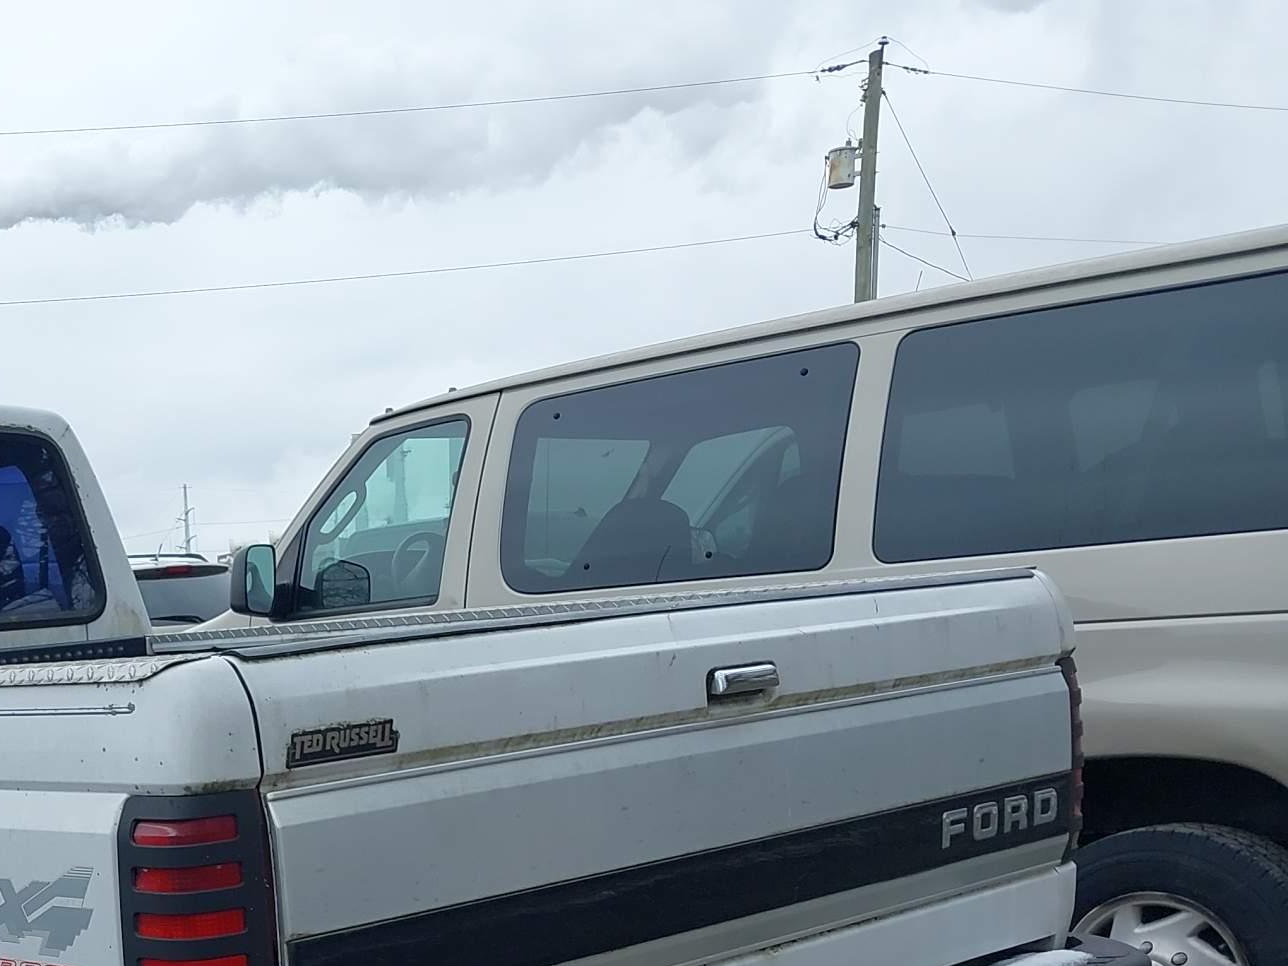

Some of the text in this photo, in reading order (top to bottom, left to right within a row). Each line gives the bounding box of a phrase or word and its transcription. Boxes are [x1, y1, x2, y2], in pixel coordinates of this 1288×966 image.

[294, 722, 393, 760] TED RUSSELL
[942, 787, 1059, 850] FORD
